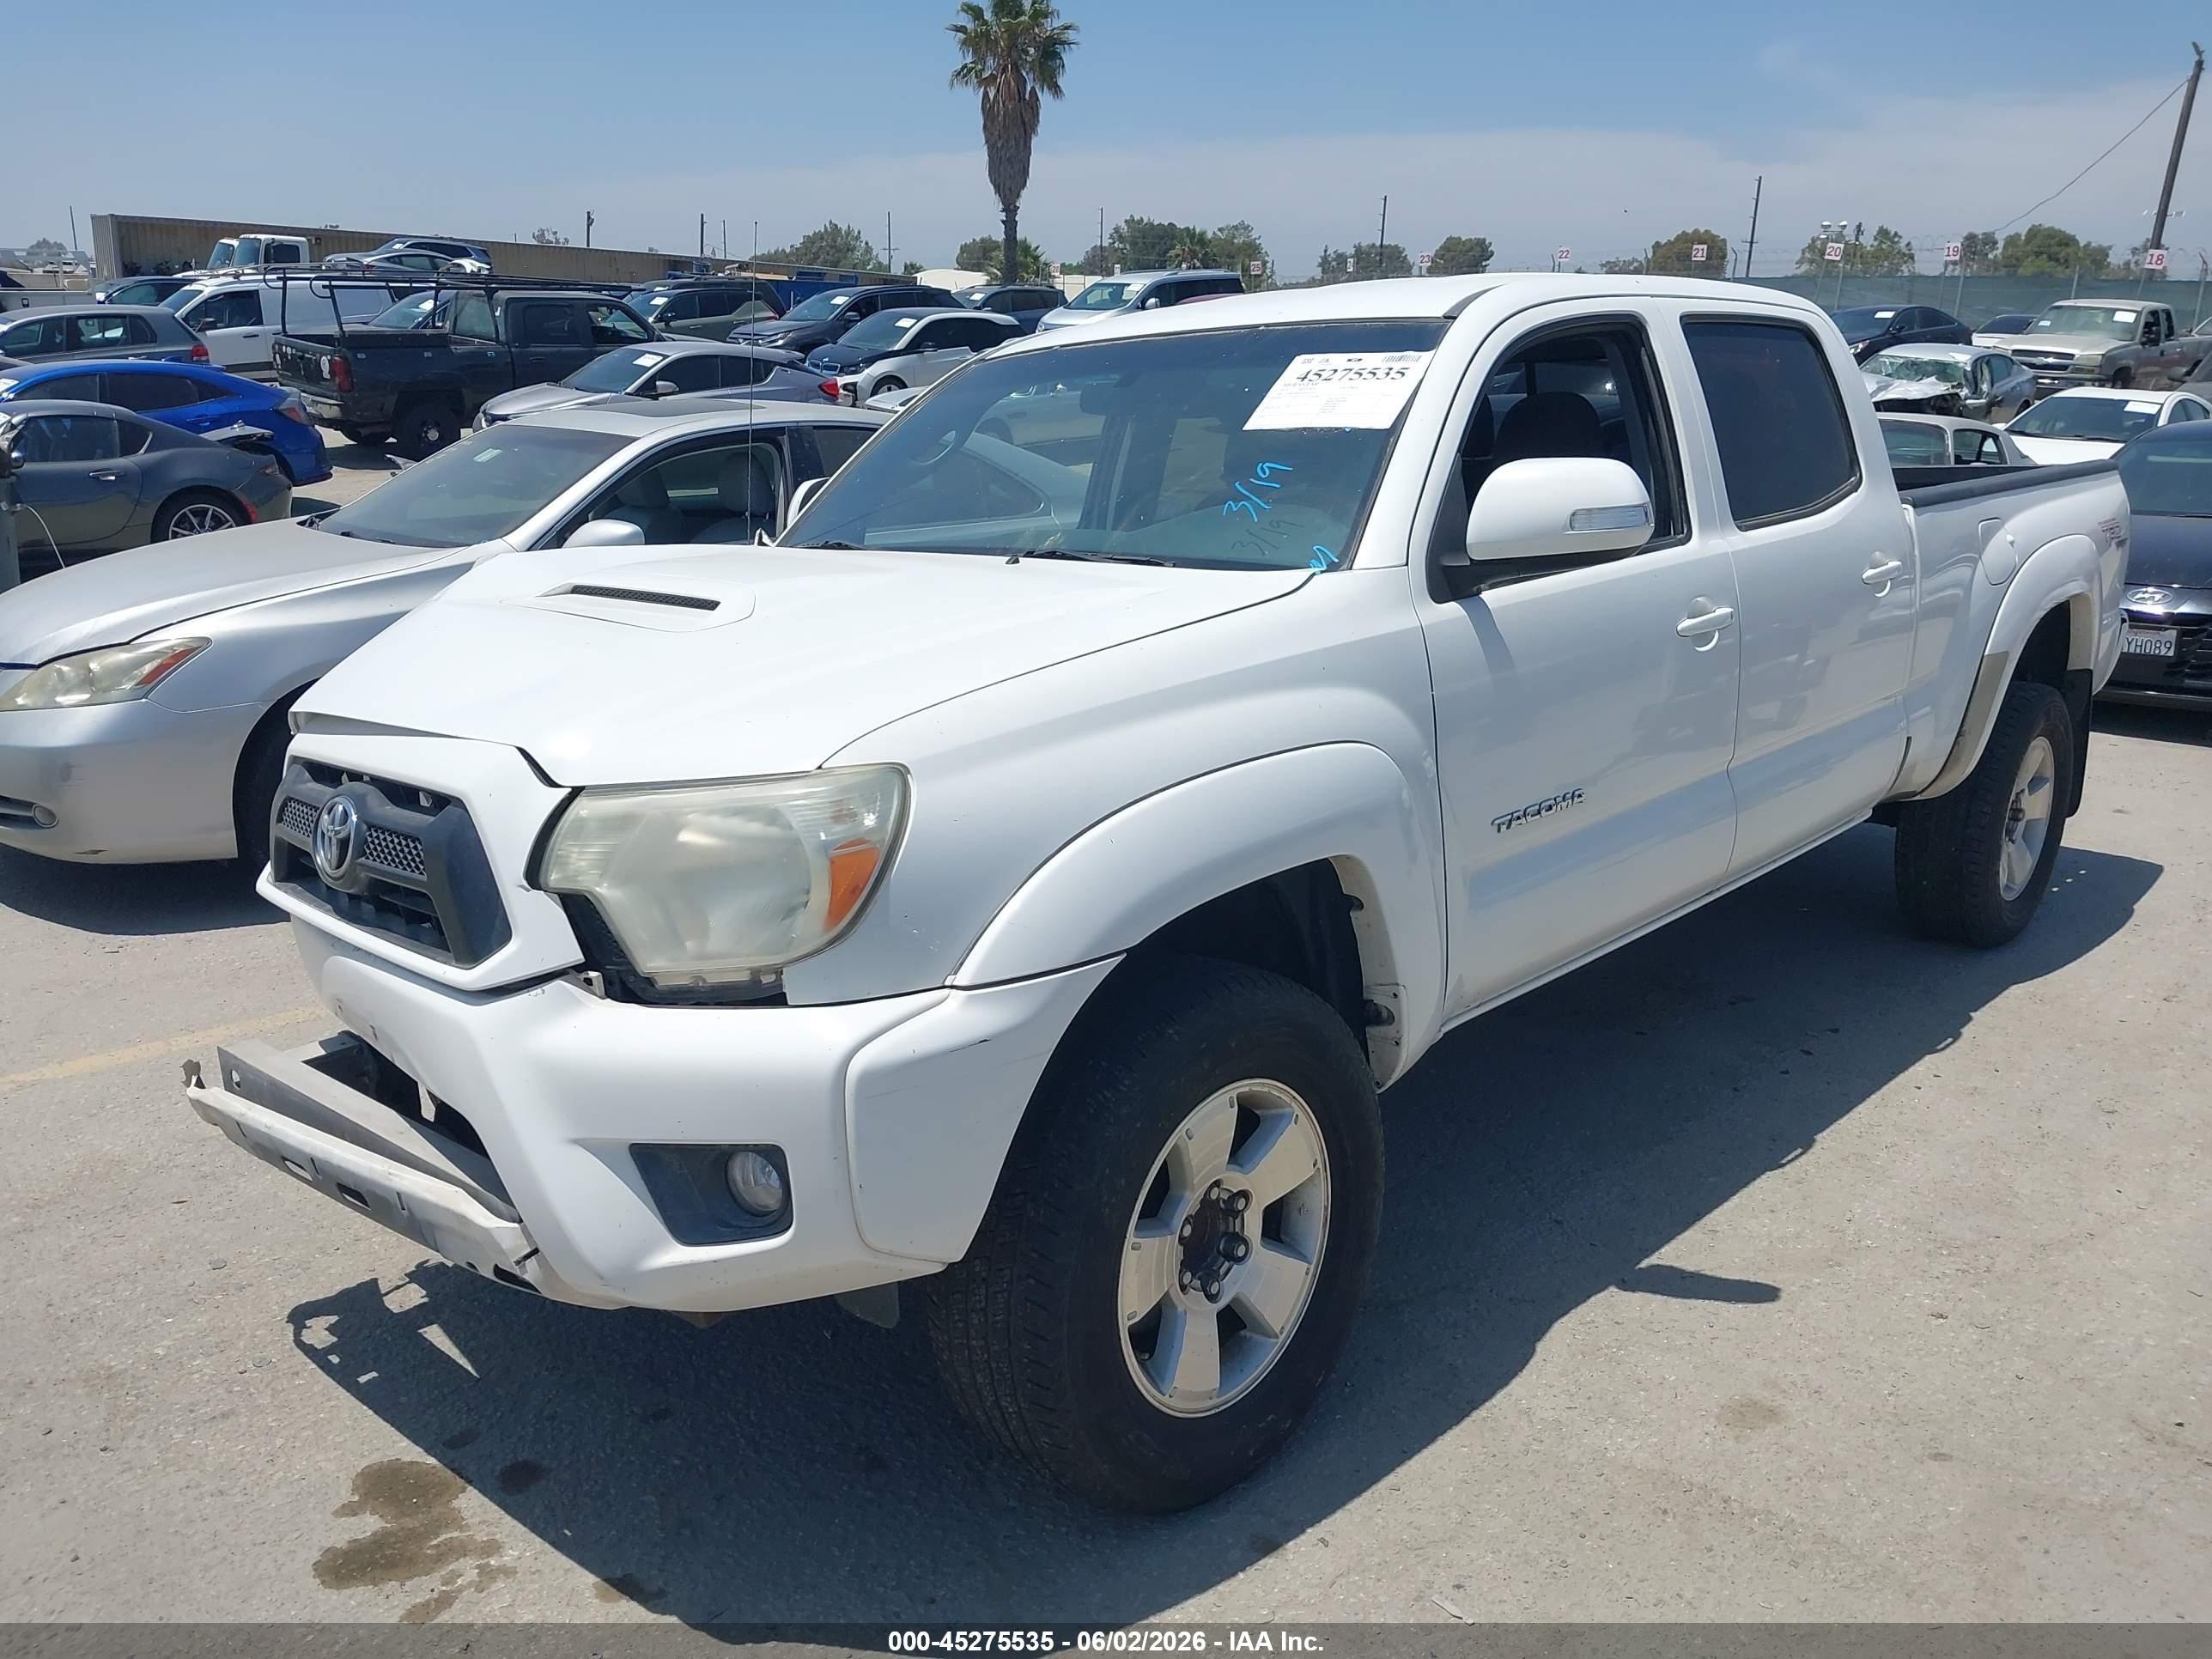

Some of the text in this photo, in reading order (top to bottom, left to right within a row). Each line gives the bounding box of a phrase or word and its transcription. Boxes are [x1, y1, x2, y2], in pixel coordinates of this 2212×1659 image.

[1559, 249, 1570, 259] 22
[1693, 247, 1705, 258] 21
[1826, 246, 1842, 257] 20
[1944, 246, 1960, 257] 19
[1419, 254, 1431, 264] 23
[2147, 252, 2165, 265] 18
[1251, 263, 1261, 272] 25
[1296, 367, 1411, 383] 45275535
[1491, 787, 1587, 834] TACOMA
